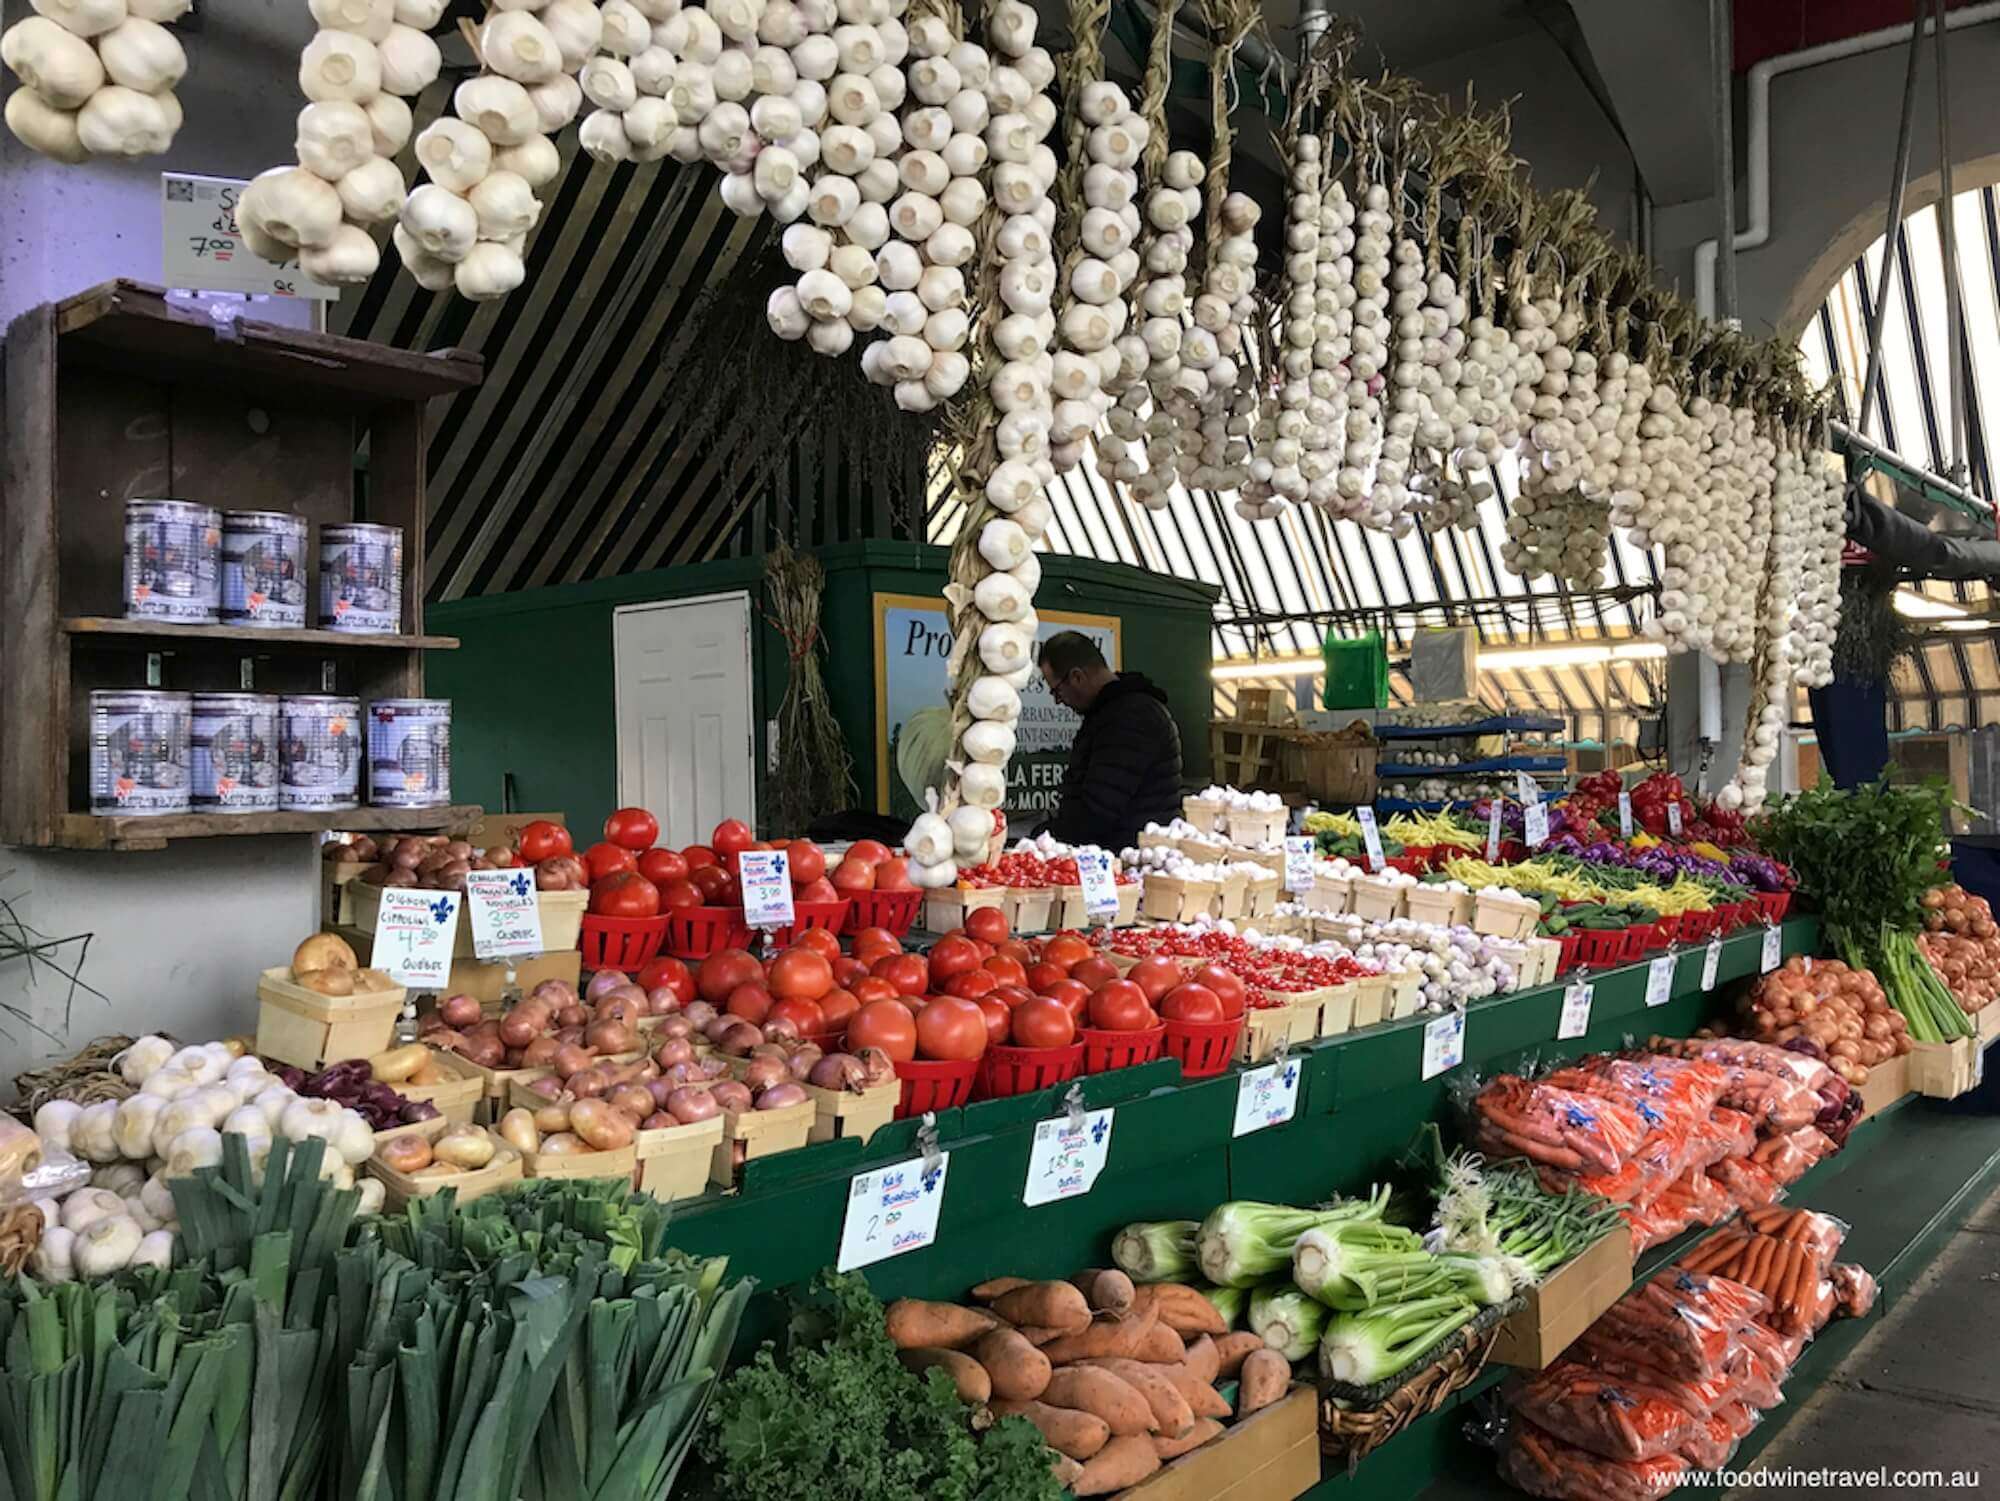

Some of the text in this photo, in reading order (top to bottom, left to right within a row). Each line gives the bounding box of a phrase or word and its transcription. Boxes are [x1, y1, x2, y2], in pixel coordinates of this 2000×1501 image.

[903, 619, 953, 659] Pro
[1031, 762, 1069, 787] FER
[1018, 790, 1064, 811] MOIS
